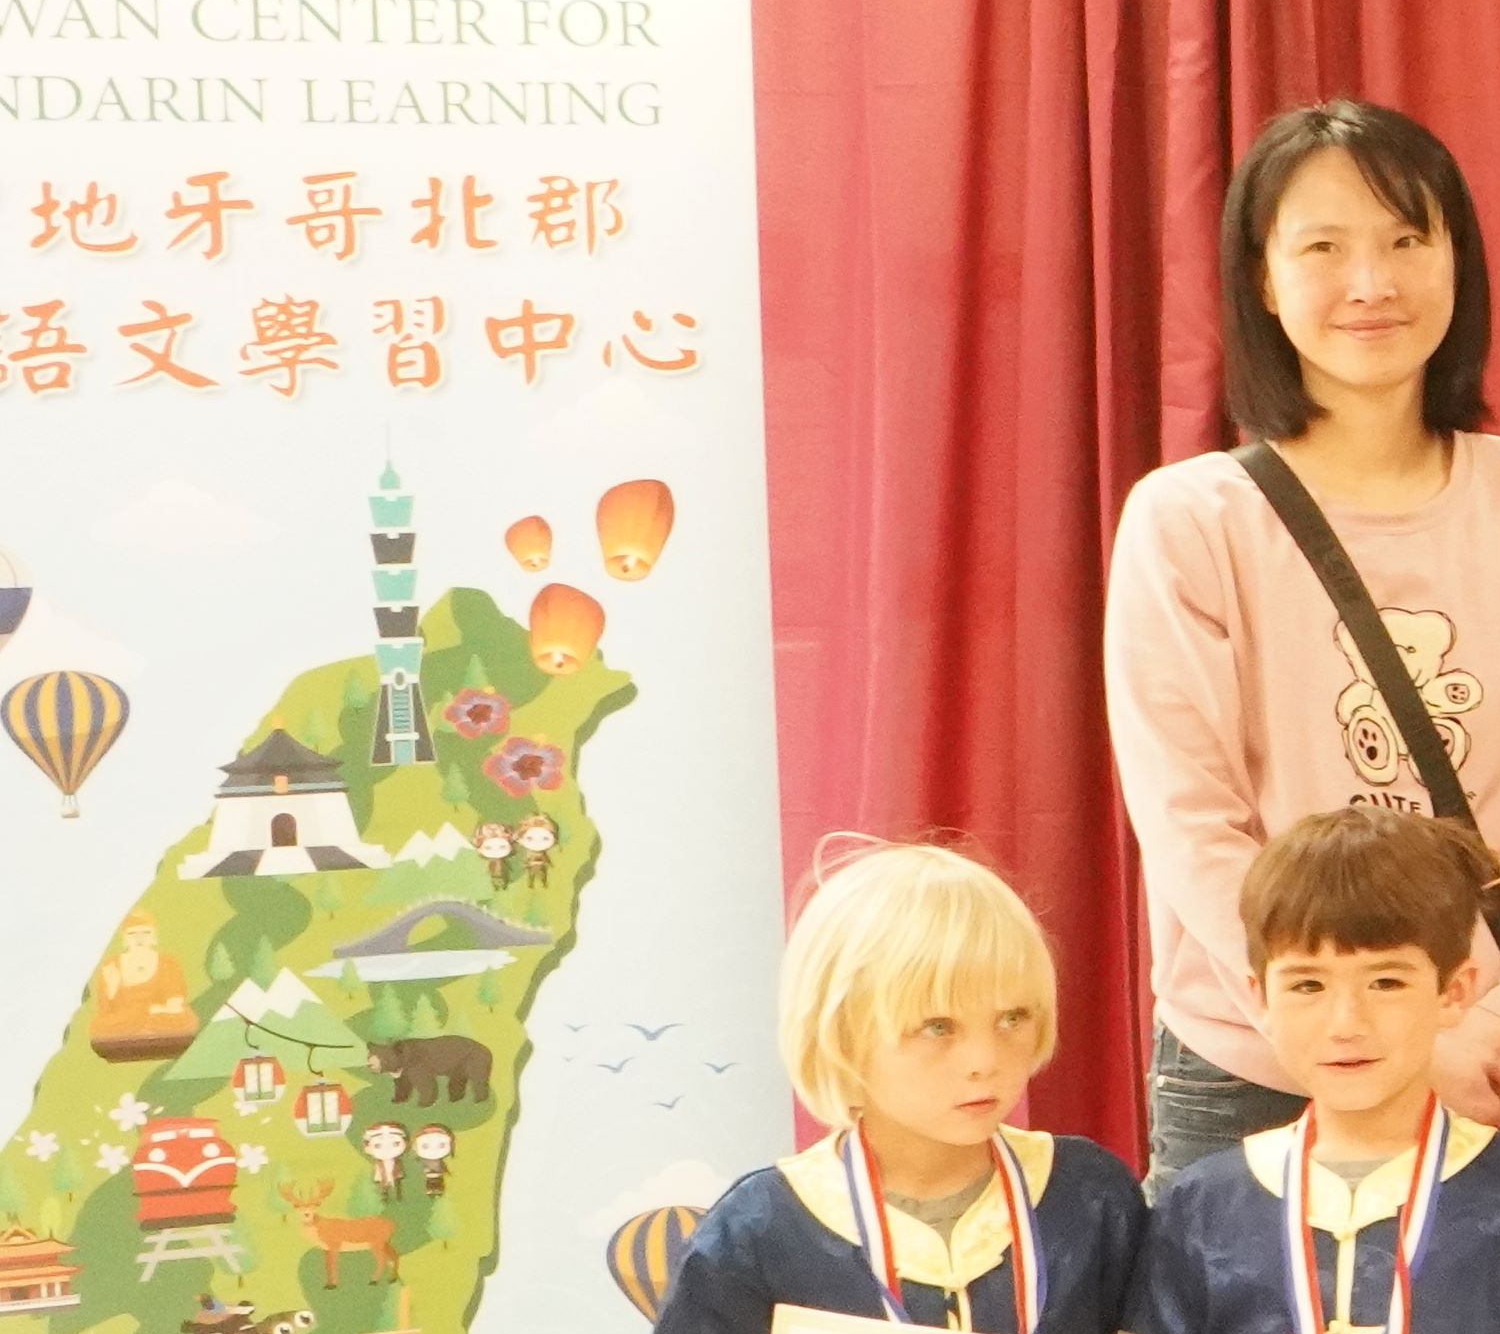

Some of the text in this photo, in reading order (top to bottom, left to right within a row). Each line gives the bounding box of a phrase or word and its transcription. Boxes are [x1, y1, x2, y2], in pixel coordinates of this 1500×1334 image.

[300, 78, 664, 127] LEARNING
[29, 171, 628, 262] 地牙哥北郡
[0, 292, 702, 399] 語文學習中心
